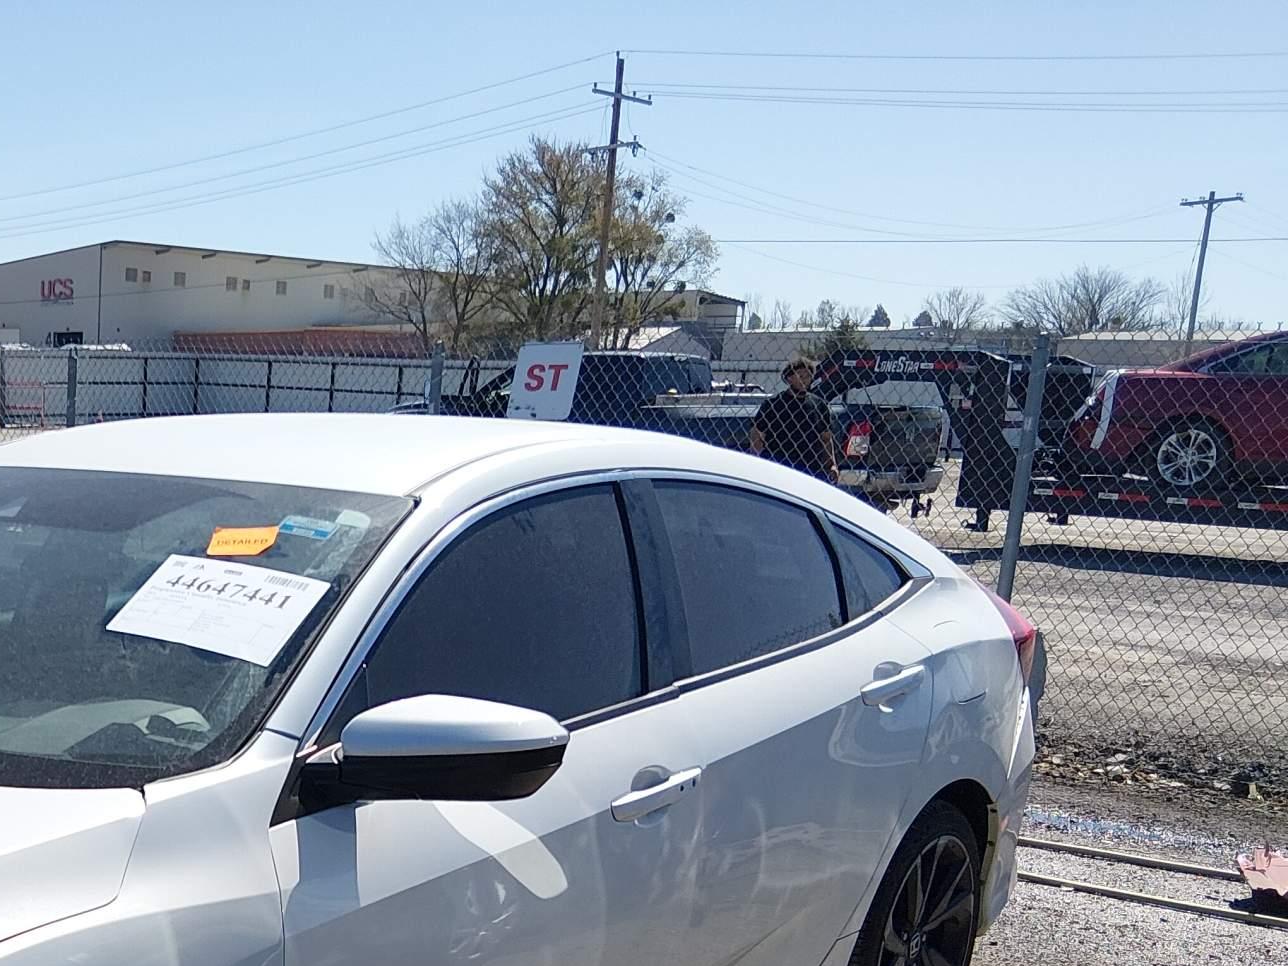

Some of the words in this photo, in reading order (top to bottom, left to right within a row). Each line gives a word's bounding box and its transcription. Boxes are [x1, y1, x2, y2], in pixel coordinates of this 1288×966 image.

[40, 279, 74, 300] UCS
[524, 363, 569, 392] ST
[216, 537, 269, 546] DETAILED
[165, 574, 293, 609] 44647441
